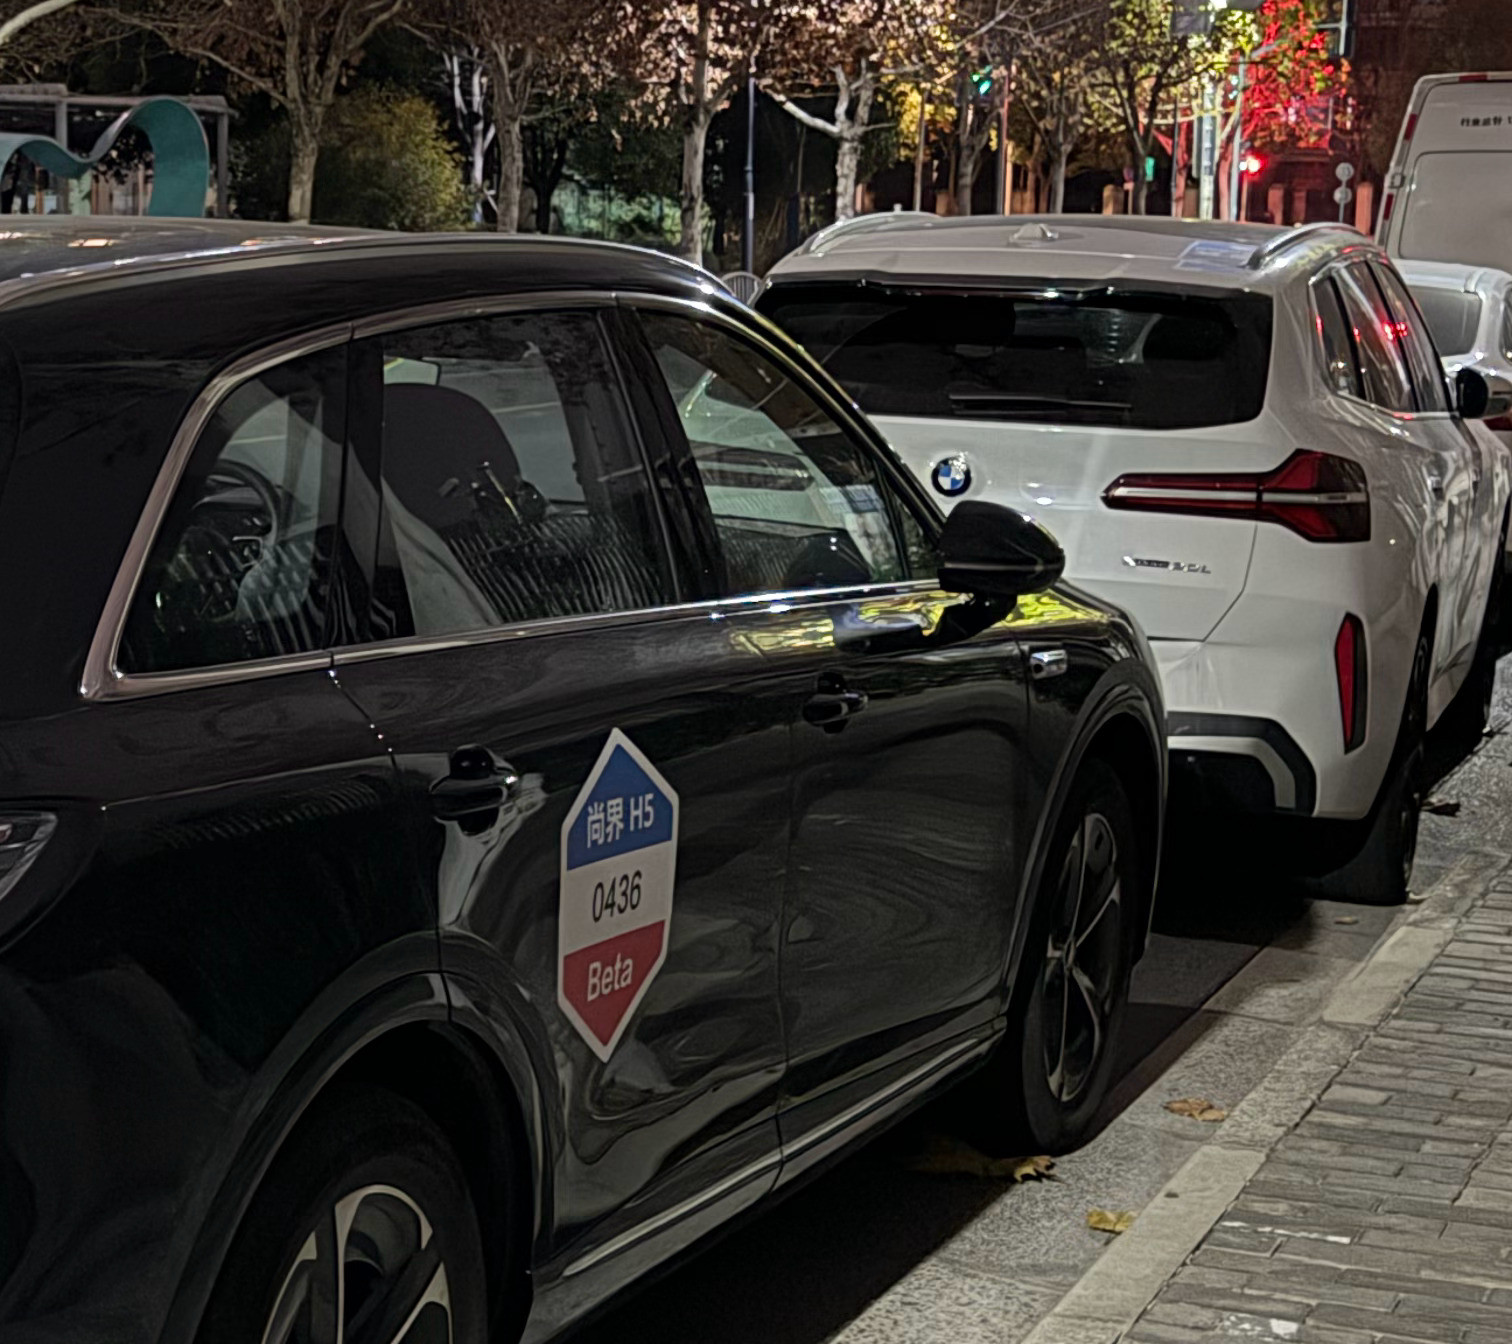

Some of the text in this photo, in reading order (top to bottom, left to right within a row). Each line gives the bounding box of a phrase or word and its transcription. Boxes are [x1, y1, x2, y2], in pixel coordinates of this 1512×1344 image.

[587, 793, 655, 849] 尚界 H5
[592, 870, 642, 924] 0436
[587, 953, 633, 1003] Beta
